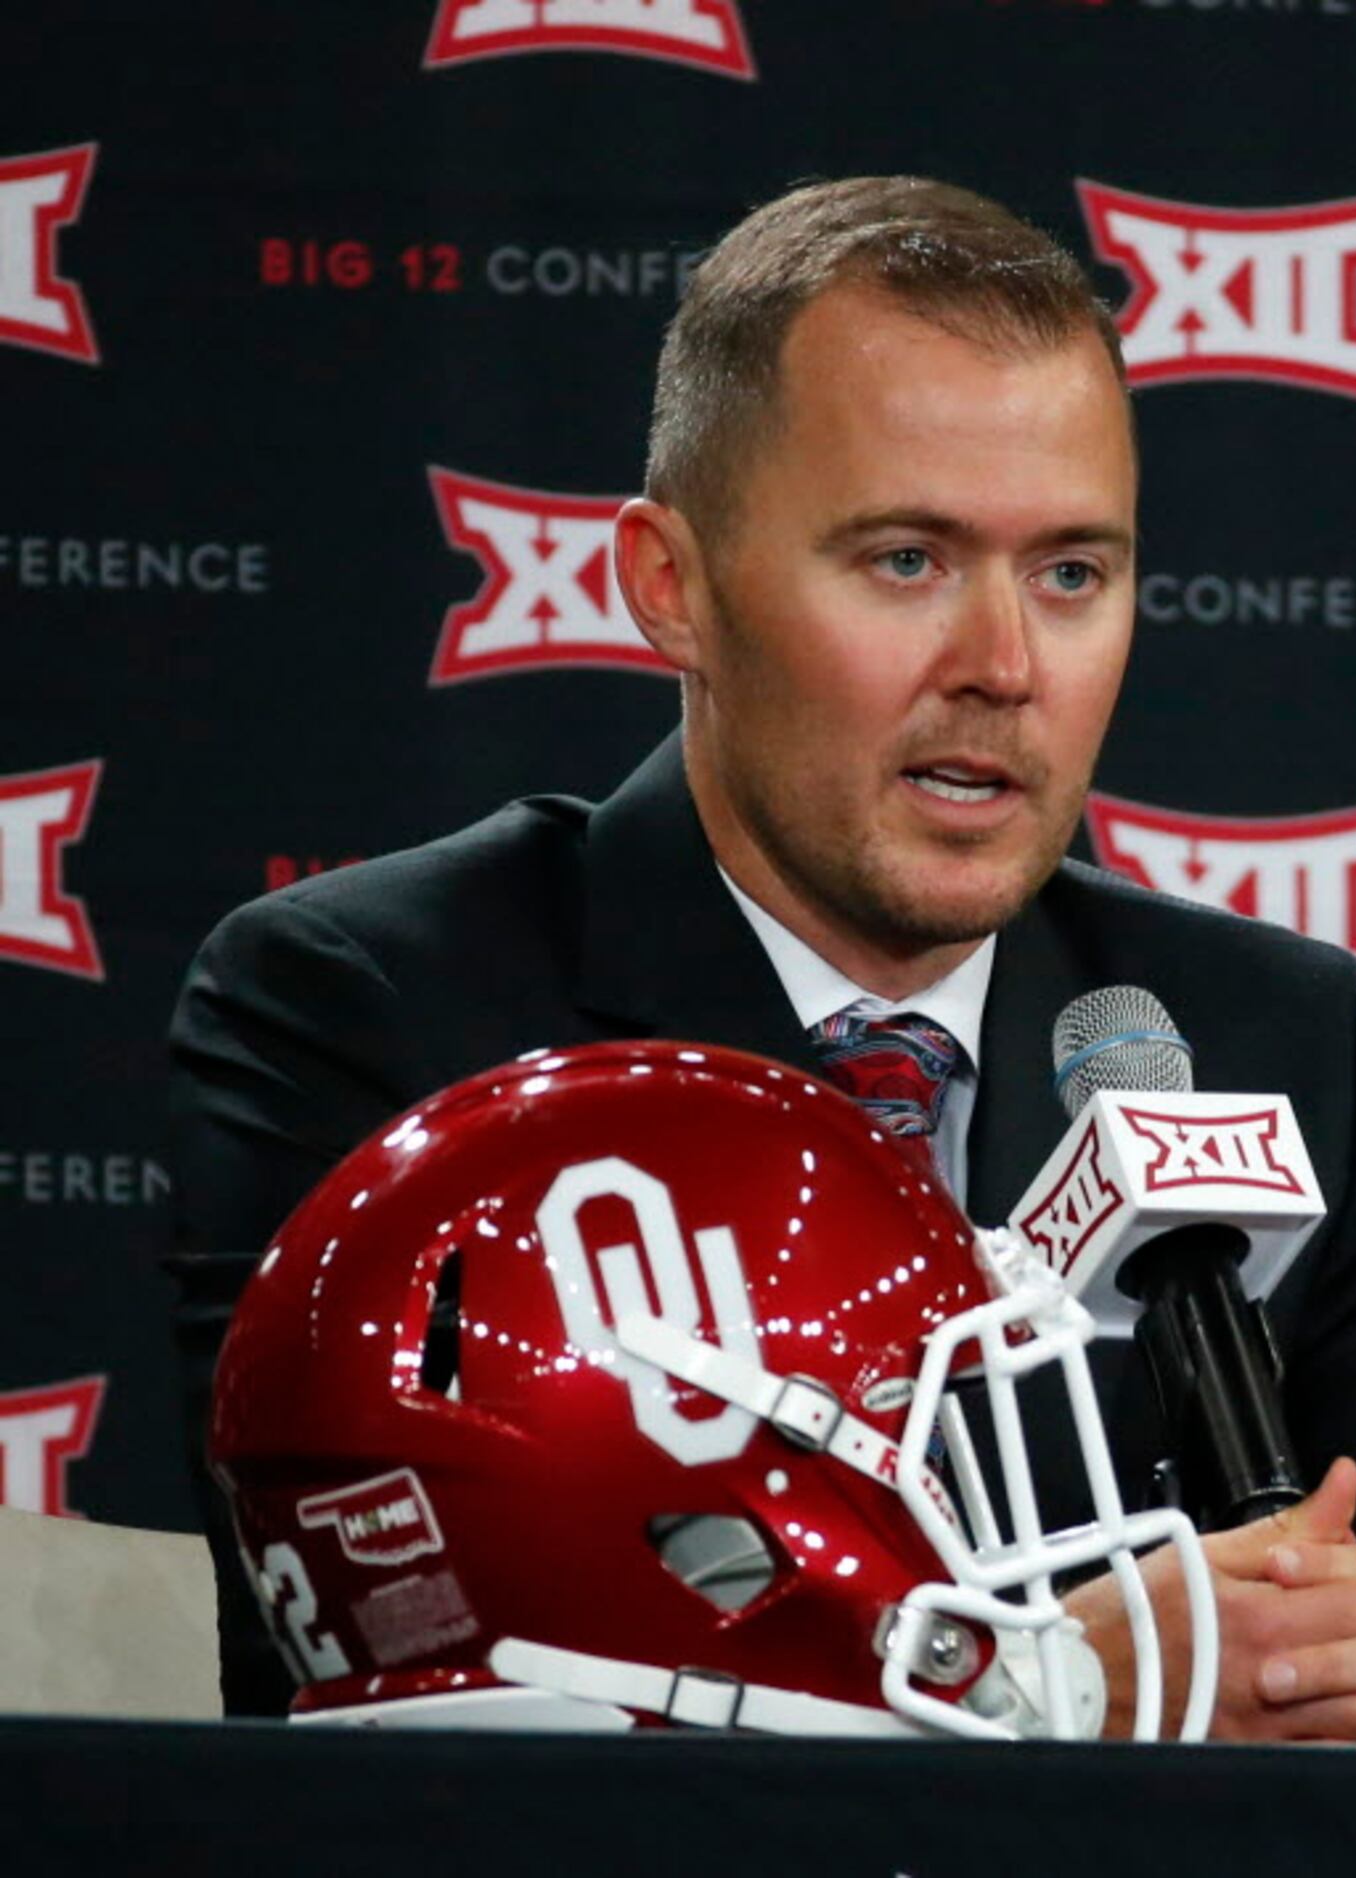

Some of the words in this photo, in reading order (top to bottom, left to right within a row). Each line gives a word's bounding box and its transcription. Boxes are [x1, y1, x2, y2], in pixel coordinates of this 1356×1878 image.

[261, 239, 371, 289] BIG
[401, 245, 460, 291] 12
[1118, 1106, 1306, 1196] XII
[535, 1154, 765, 1467] OU
